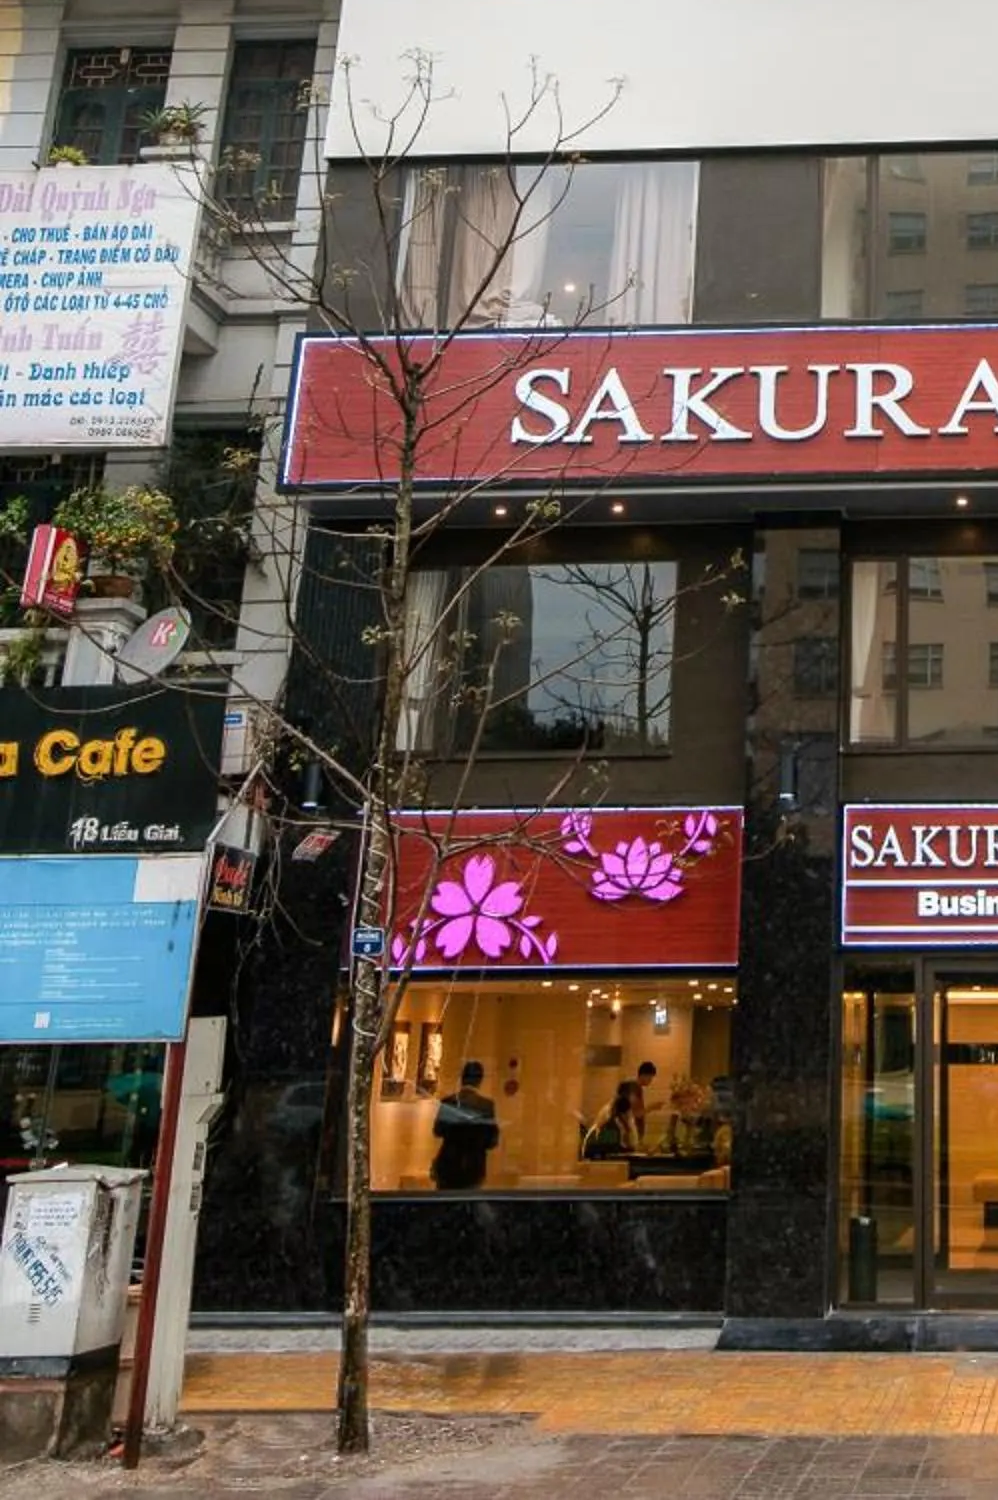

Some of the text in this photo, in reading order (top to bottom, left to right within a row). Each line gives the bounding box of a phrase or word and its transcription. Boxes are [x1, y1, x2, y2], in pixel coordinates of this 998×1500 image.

[12, 227, 36, 243] CHO
[58, 248, 96, 264] TRANG
[33, 292, 58, 311] CÁC
[70, 388, 103, 406] các
[35, 726, 167, 781] Cafe
[71, 816, 98, 842] 18
